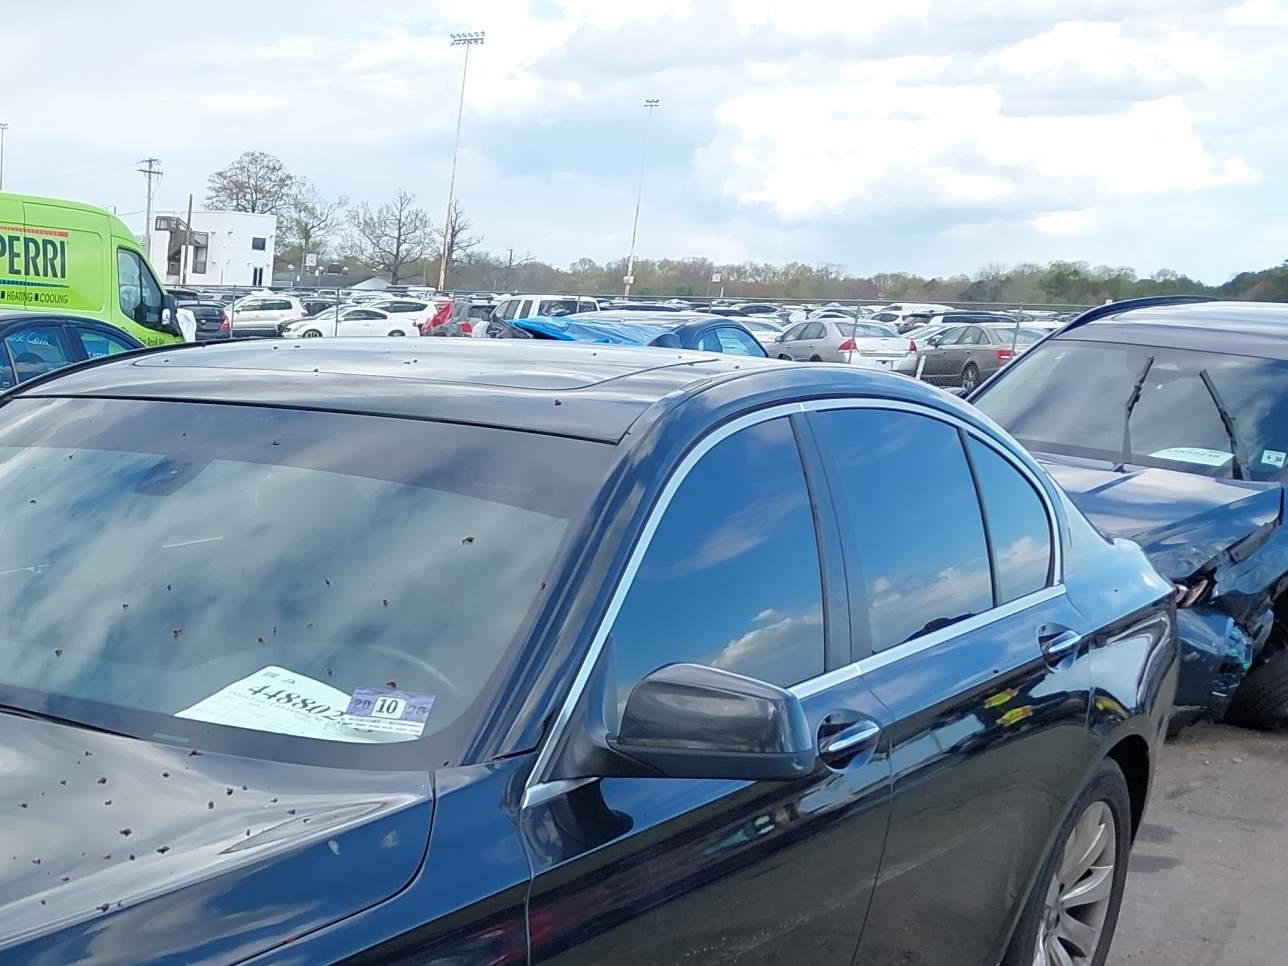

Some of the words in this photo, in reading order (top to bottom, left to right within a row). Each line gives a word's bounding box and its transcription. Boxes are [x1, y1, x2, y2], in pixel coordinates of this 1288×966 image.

[7, 291, 33, 302] HEATING
[40, 293, 69, 304] COOLING
[375, 698, 399, 714] 10
